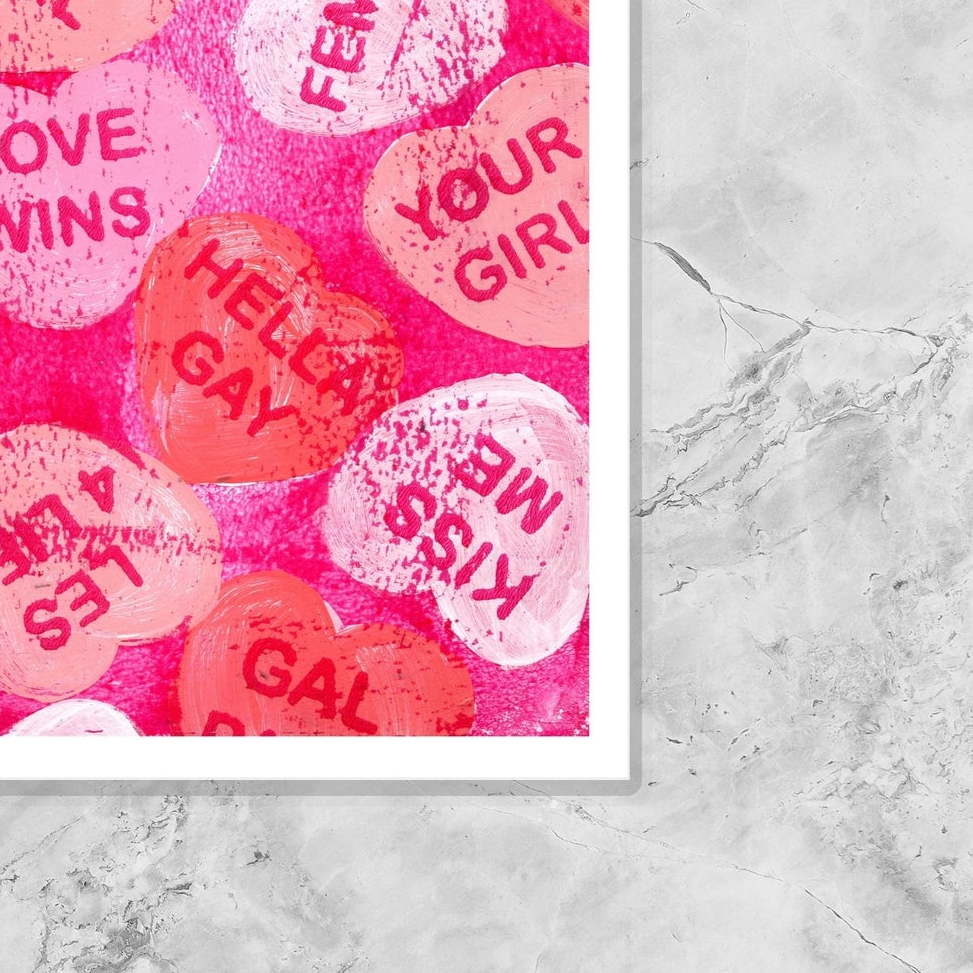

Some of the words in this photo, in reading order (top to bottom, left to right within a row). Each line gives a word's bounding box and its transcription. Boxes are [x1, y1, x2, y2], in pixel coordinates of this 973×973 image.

[395, 116, 582, 240] YOUR
[454, 201, 589, 302] GIRL
[185, 239, 362, 415] HELLA
[172, 331, 298, 438] GAY
[77, 466, 116, 514] 4
[455, 434, 564, 534] ME
[23, 544, 144, 651] LES
[386, 482, 542, 620] KISS
[242, 637, 378, 735] GAL
